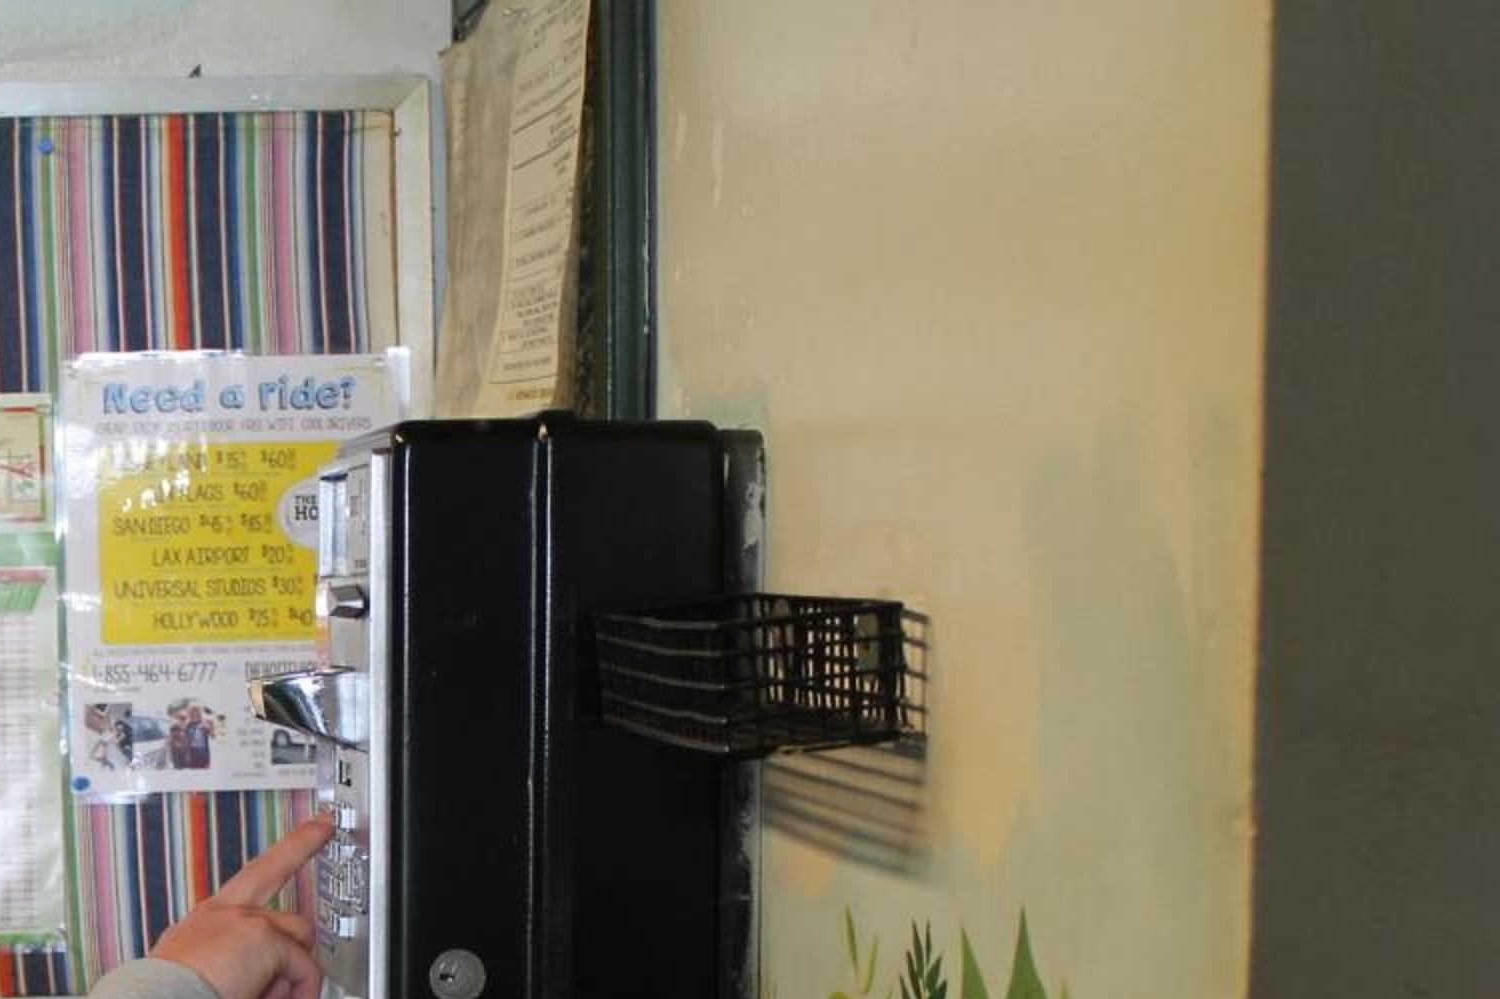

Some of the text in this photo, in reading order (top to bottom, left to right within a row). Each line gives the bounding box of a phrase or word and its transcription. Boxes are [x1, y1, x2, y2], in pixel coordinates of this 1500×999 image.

[103, 374, 357, 415] Need a ride?
[186, 546, 250, 566] AIRPORT
[112, 577, 201, 599] UNIVERSAL
